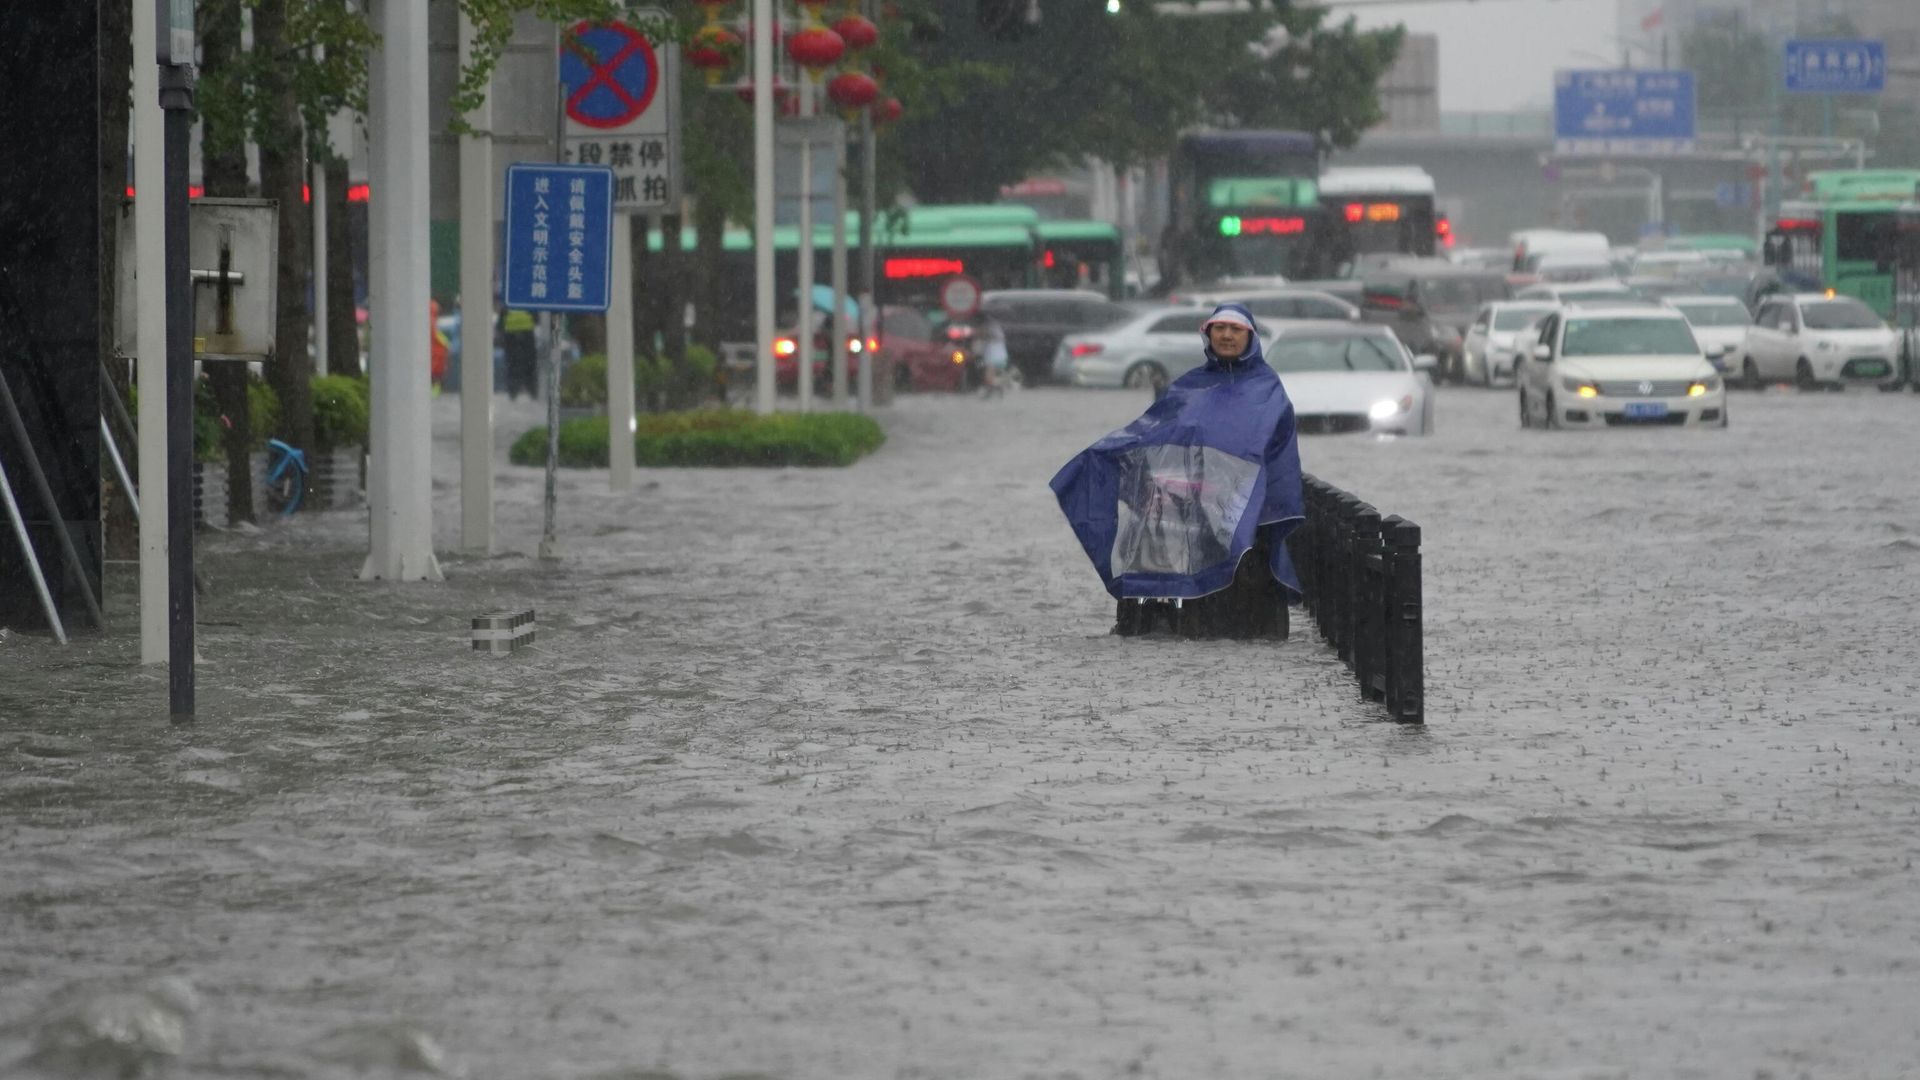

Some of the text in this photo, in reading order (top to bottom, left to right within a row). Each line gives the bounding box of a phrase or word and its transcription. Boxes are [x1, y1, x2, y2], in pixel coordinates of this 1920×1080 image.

[531, 176, 550, 299] 进入文明示范路
